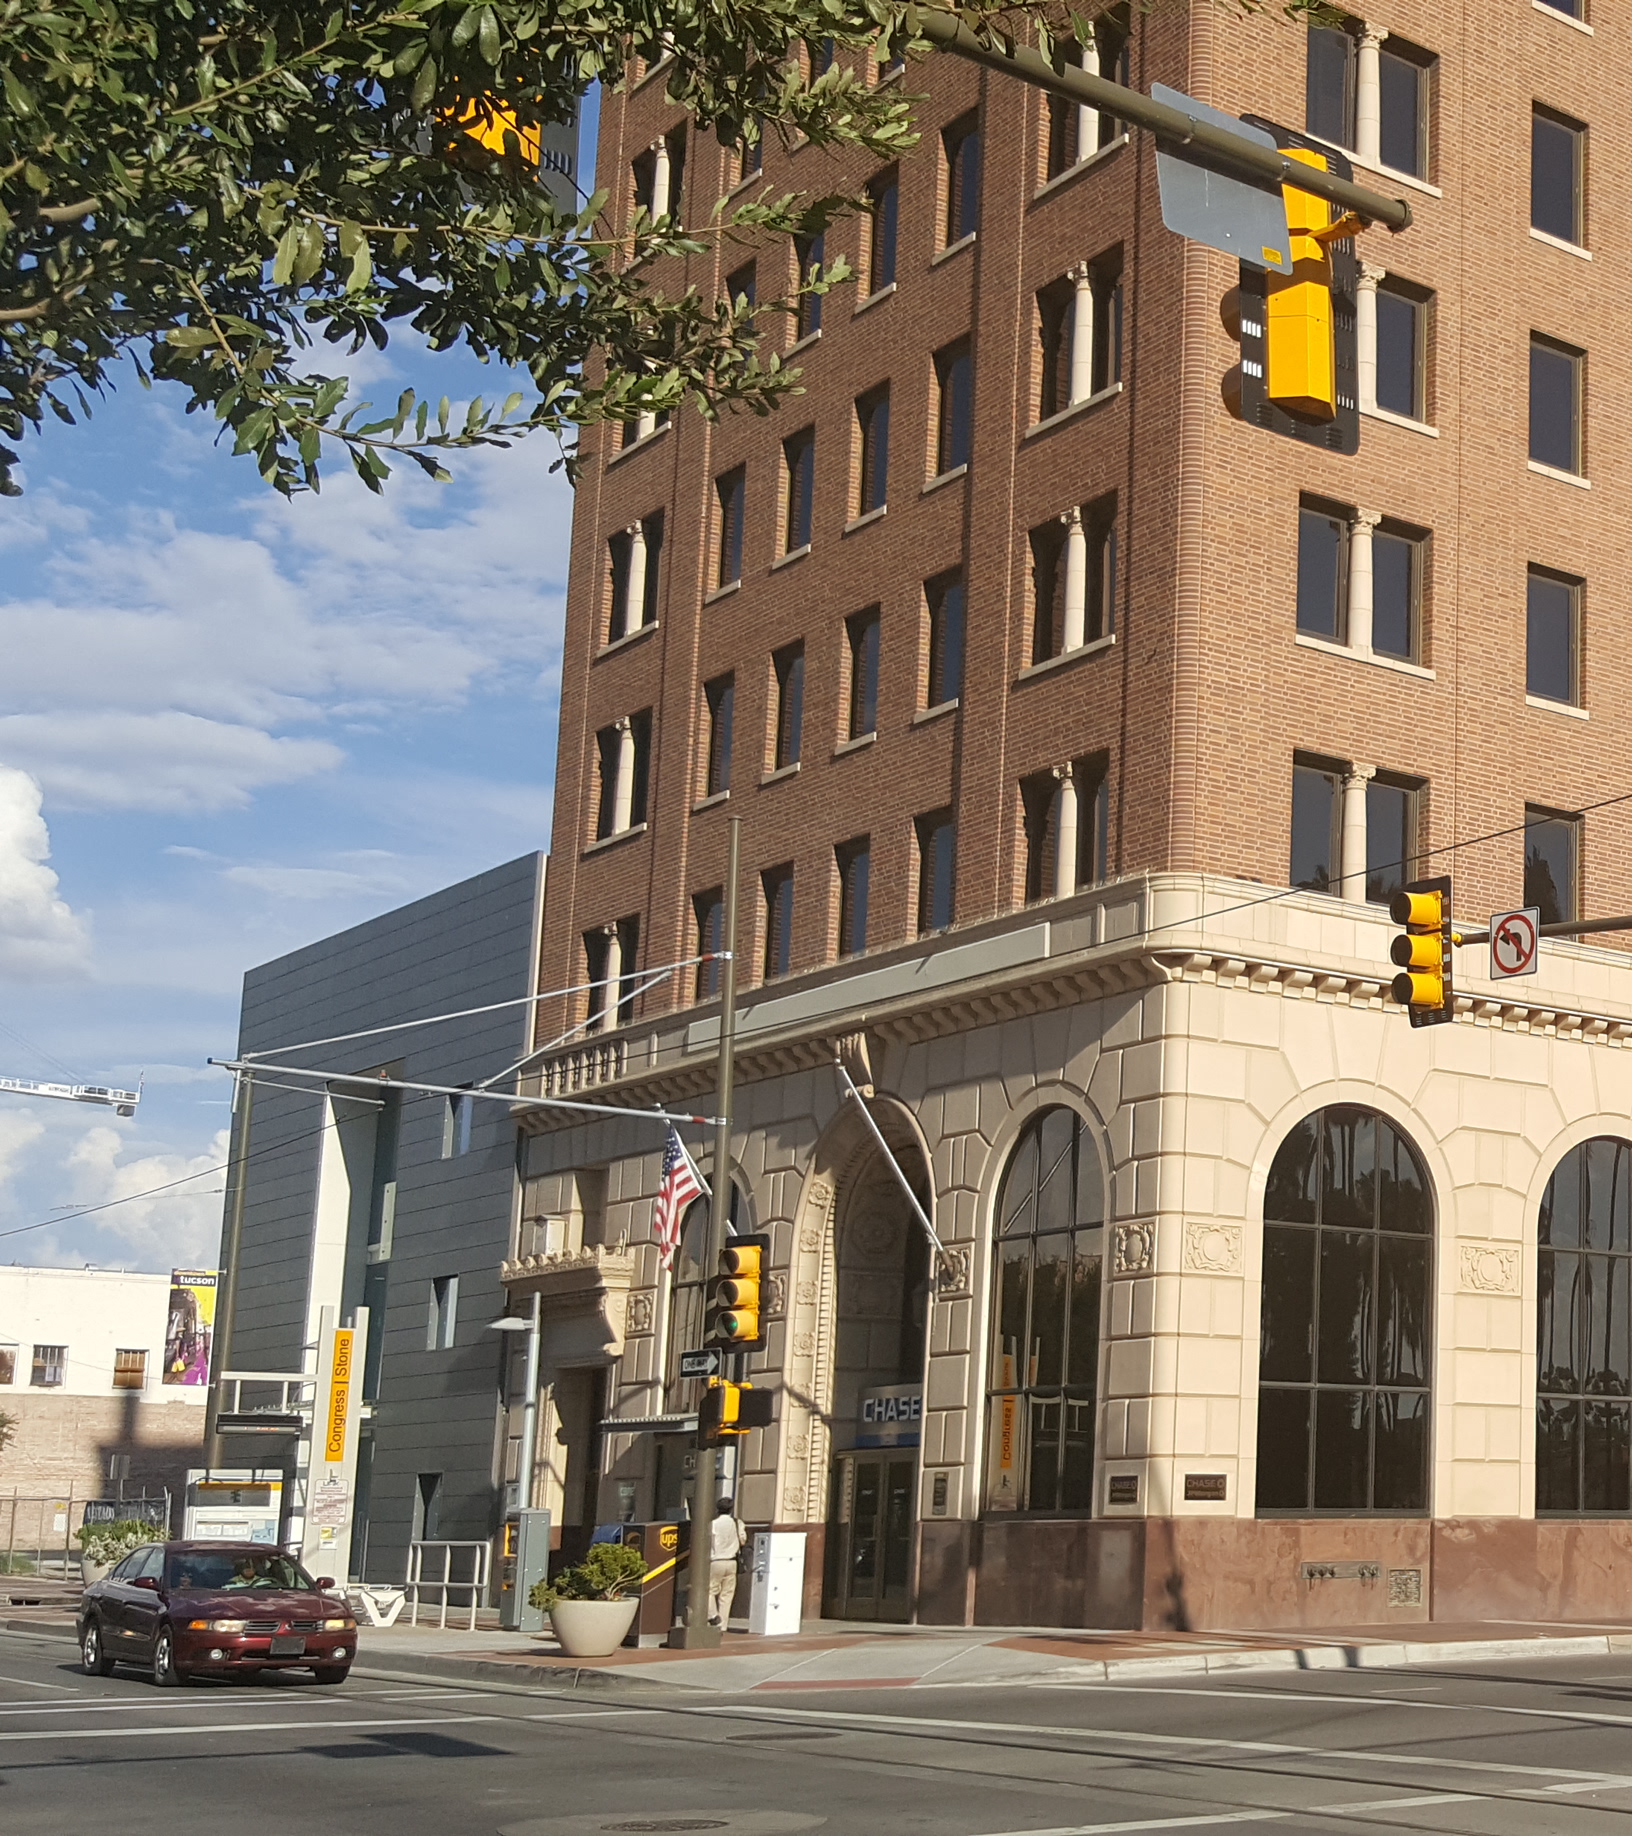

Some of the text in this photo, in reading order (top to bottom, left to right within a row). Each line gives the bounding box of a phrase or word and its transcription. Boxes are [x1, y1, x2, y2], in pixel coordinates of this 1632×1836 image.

[180, 1275, 215, 1285] tucson
[329, 1338, 350, 1453] Congress Stone
[863, 1396, 921, 1422] CHASE
[1187, 1479, 1216, 1487] CHASE
[661, 1533, 678, 1548] ups
